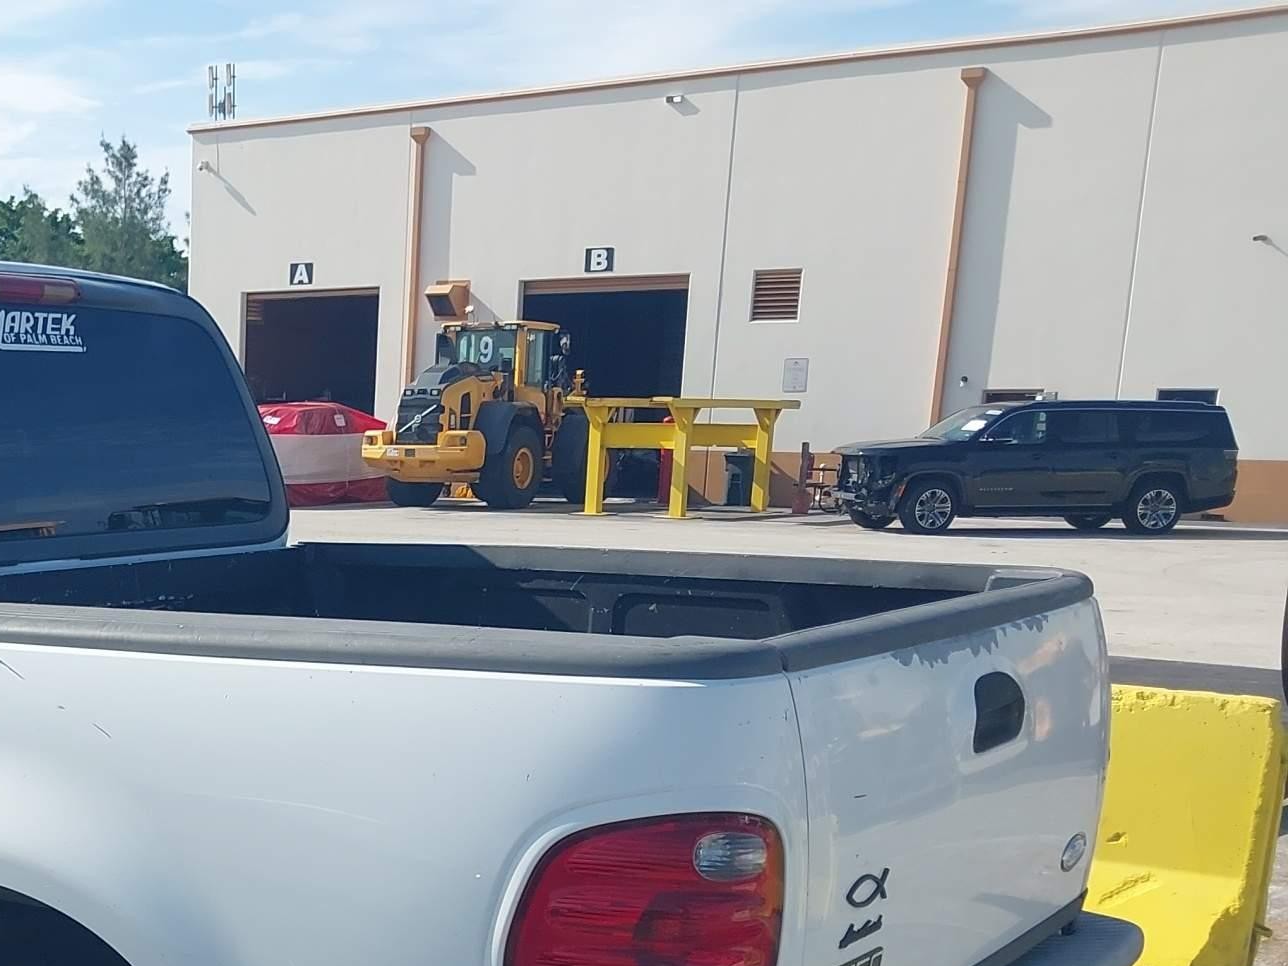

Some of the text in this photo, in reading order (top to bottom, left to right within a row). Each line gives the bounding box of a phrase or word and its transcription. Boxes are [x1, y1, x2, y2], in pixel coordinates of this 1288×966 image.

[590, 248, 609, 271] B
[292, 264, 310, 284] A
[4, 333, 83, 345] OF PALM BEACH
